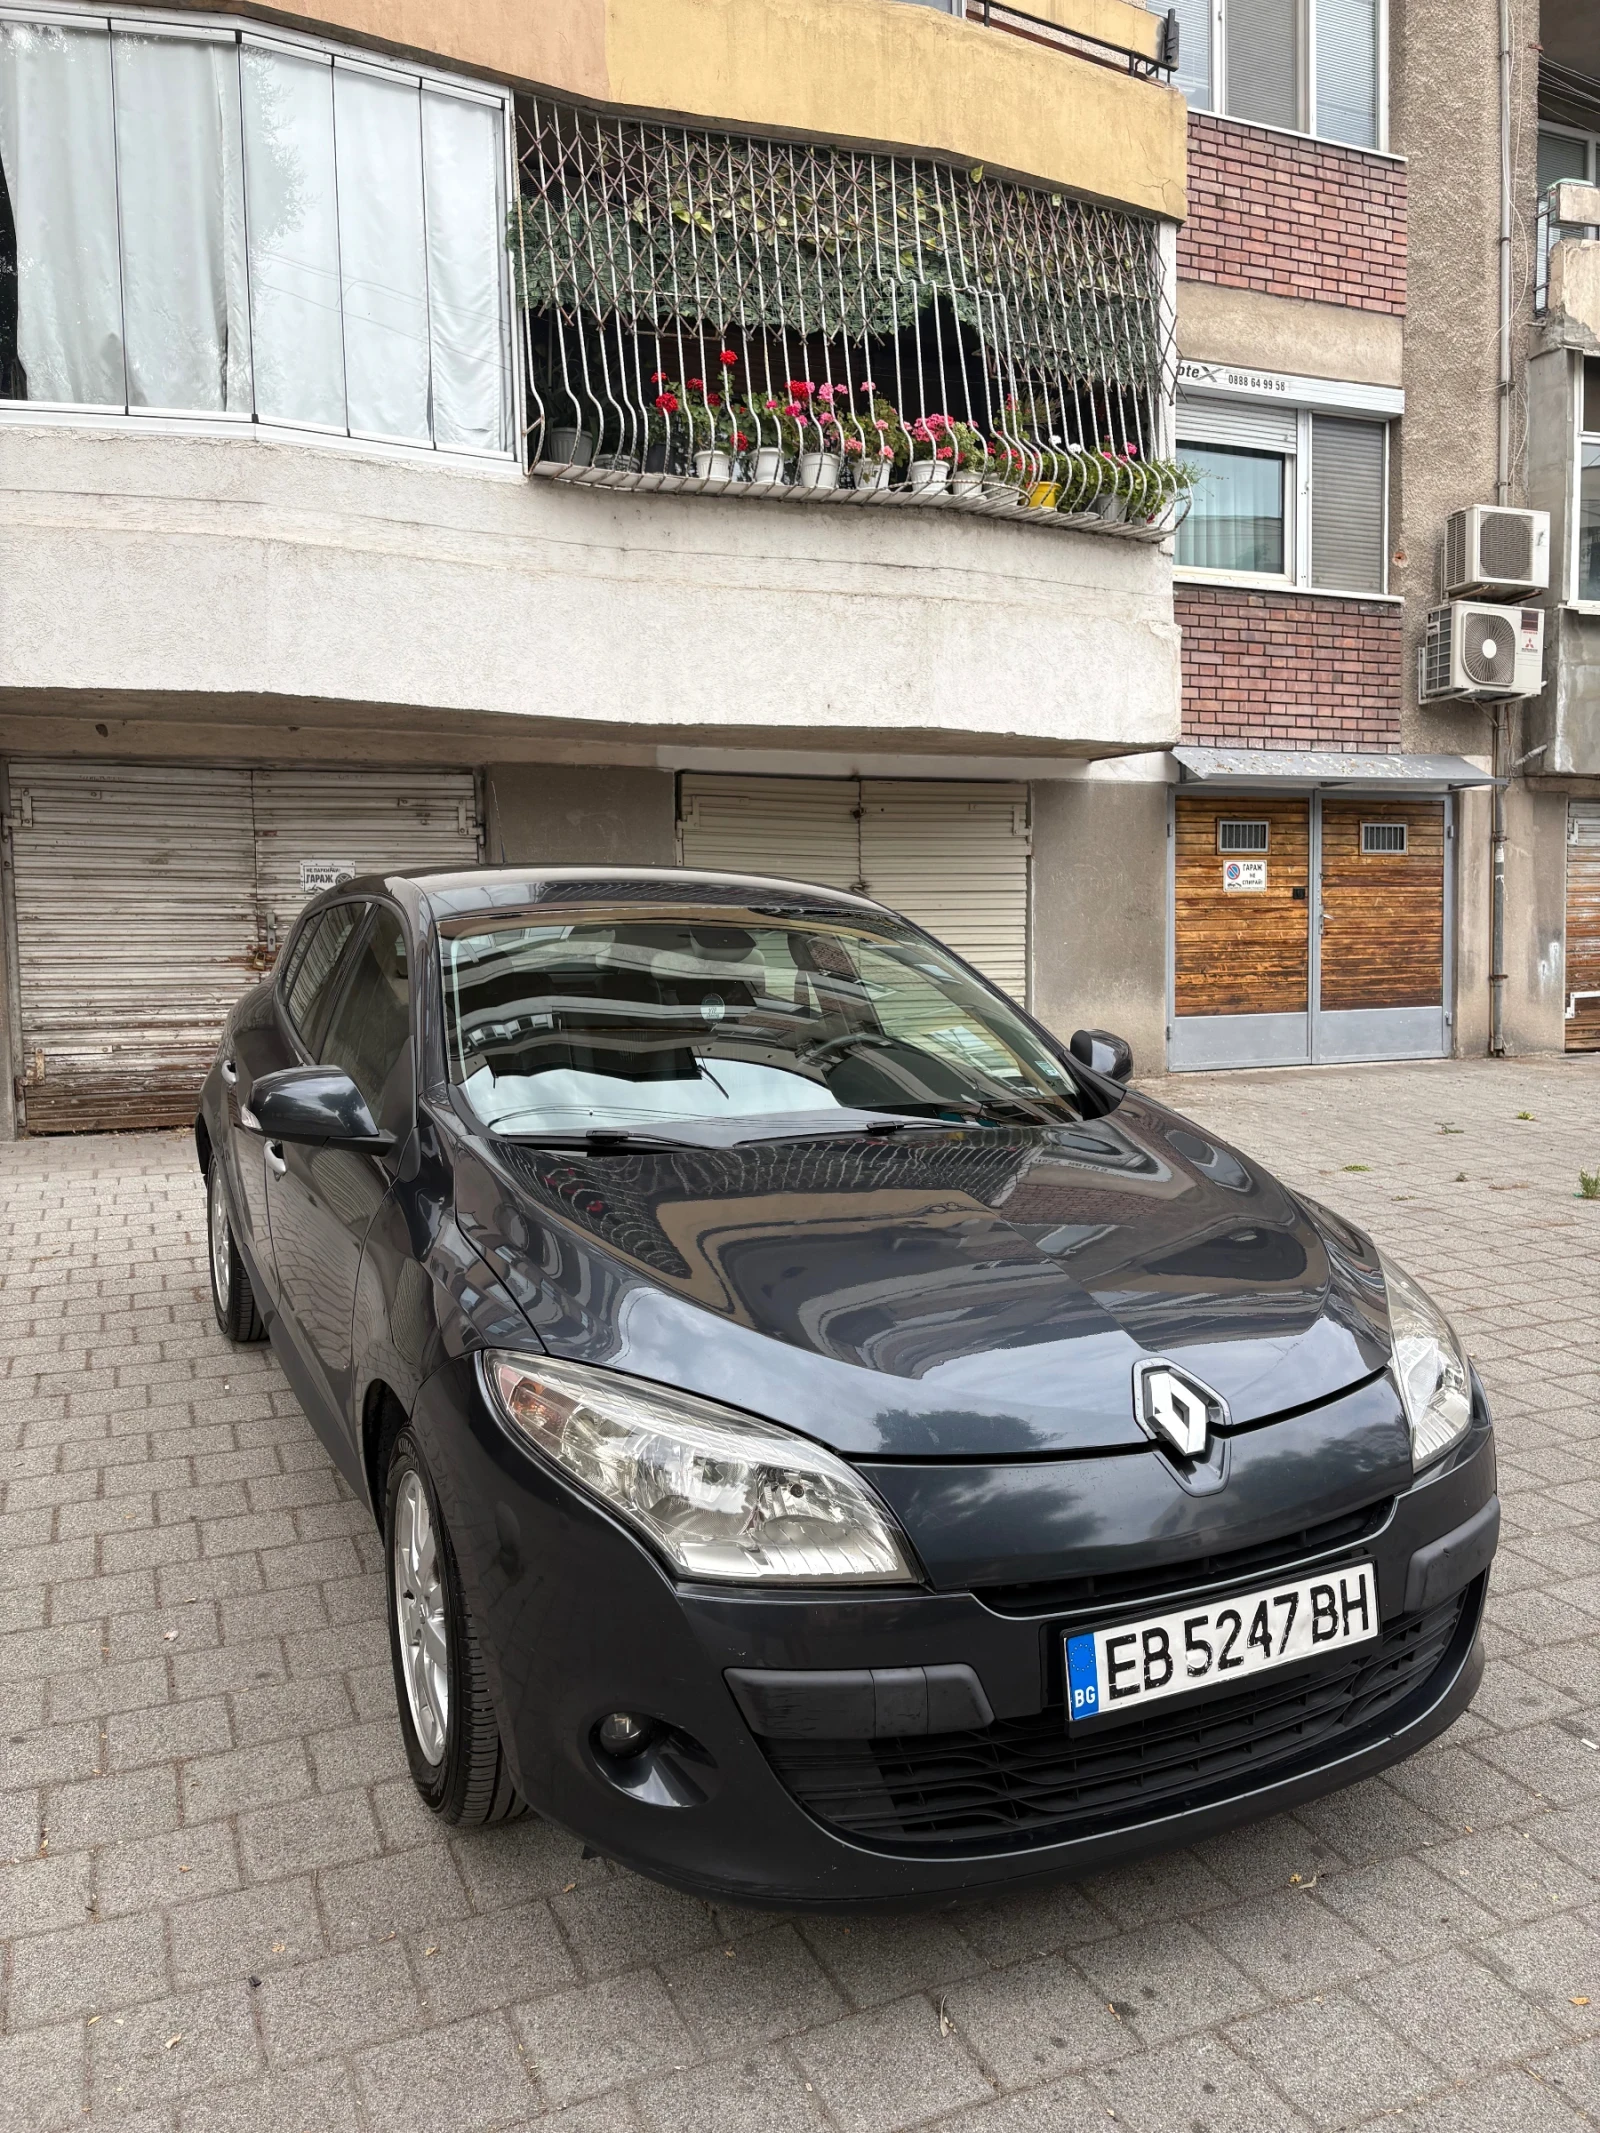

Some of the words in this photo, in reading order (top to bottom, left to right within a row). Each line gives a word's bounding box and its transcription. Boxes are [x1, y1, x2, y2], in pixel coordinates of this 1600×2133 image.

[1228, 374, 1248, 387] 0888
[1251, 377, 1261, 388] 64
[1263, 379, 1273, 390] 99
[1275, 380, 1286, 391] 58
[1242, 863, 1263, 872] ГАРАЖ
[306, 874, 333, 883] ГАРАЖ
[1105, 1626, 1174, 1701] EB
[1183, 1591, 1299, 1677] 5247
[1309, 1573, 1369, 1644] BH
[1074, 1685, 1096, 1708] BG
